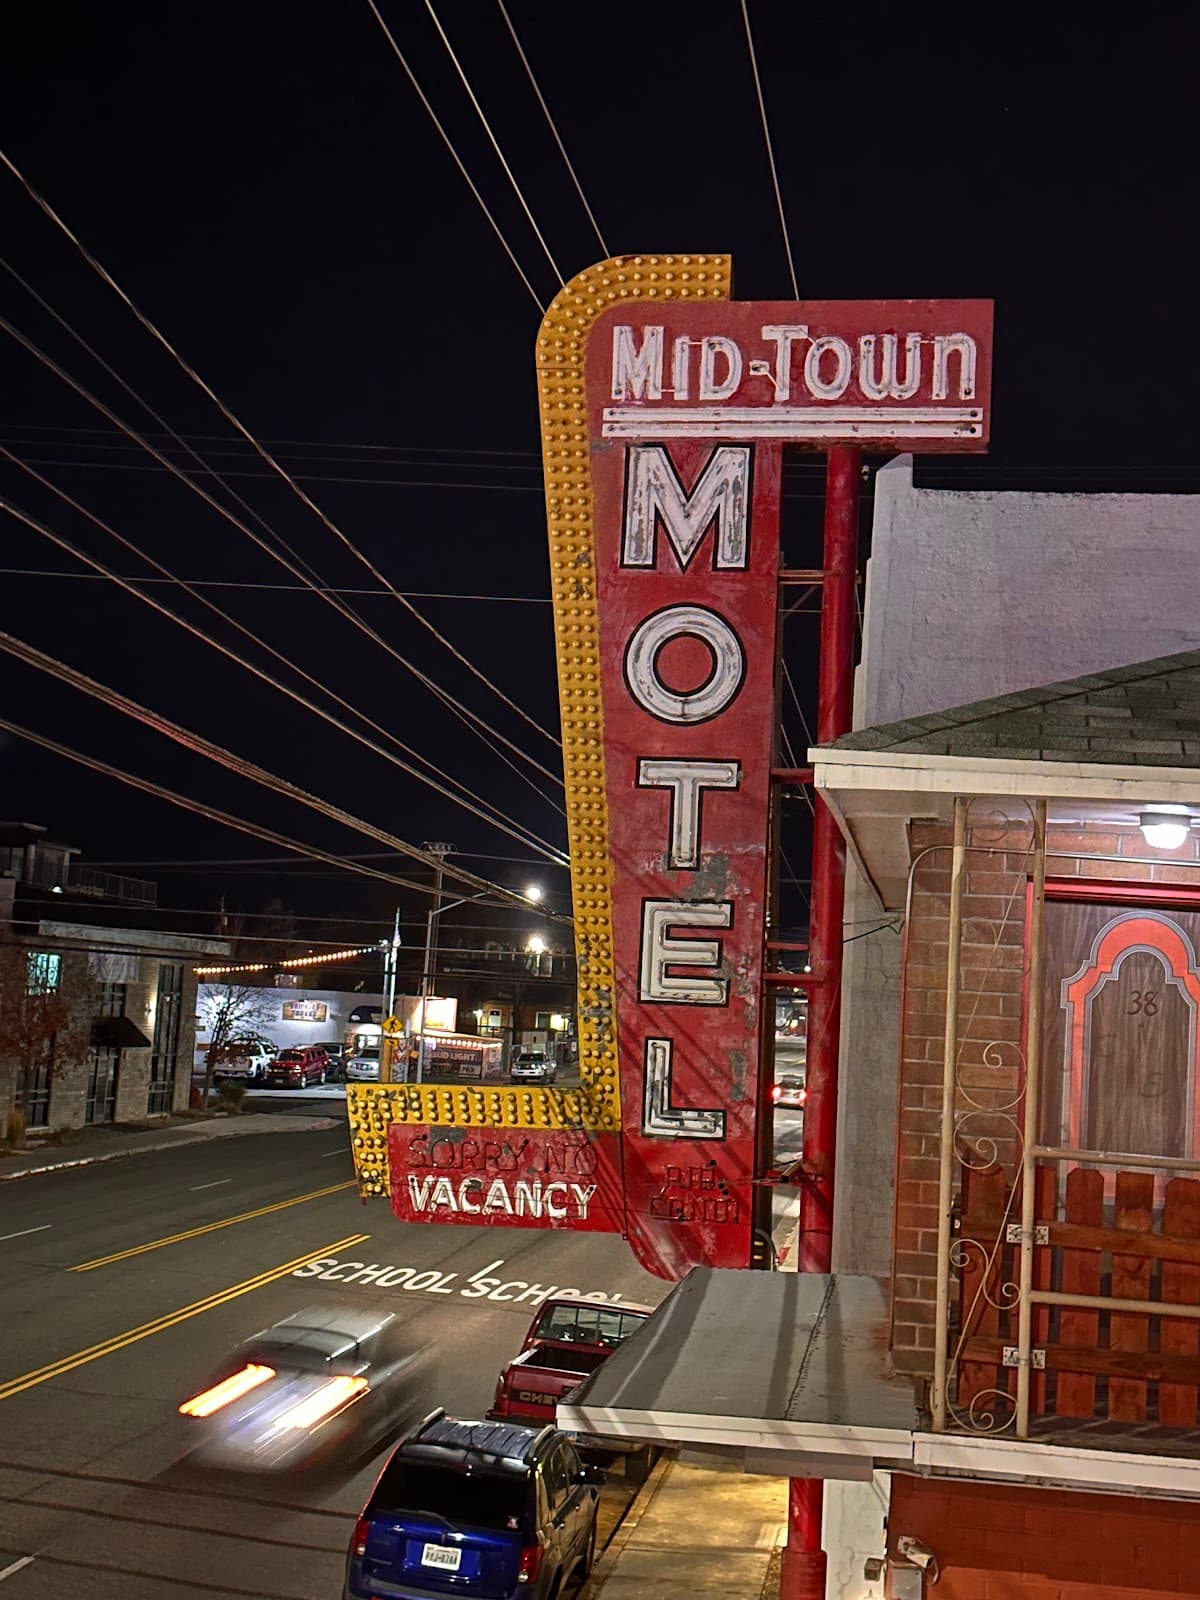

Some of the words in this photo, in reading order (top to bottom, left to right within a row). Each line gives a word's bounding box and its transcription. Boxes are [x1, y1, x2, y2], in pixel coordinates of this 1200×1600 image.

[621, 443, 754, 1140] MOTEL
[1127, 990, 1160, 1017] 38
[450, 1052, 476, 1062] LIGHT
[407, 1134, 529, 1171] SORRY
[543, 1141, 598, 1177] NO
[407, 1174, 597, 1220] VACANCY
[291, 1258, 459, 1295] SCHOOL
[461, 1276, 623, 1307] SCH
